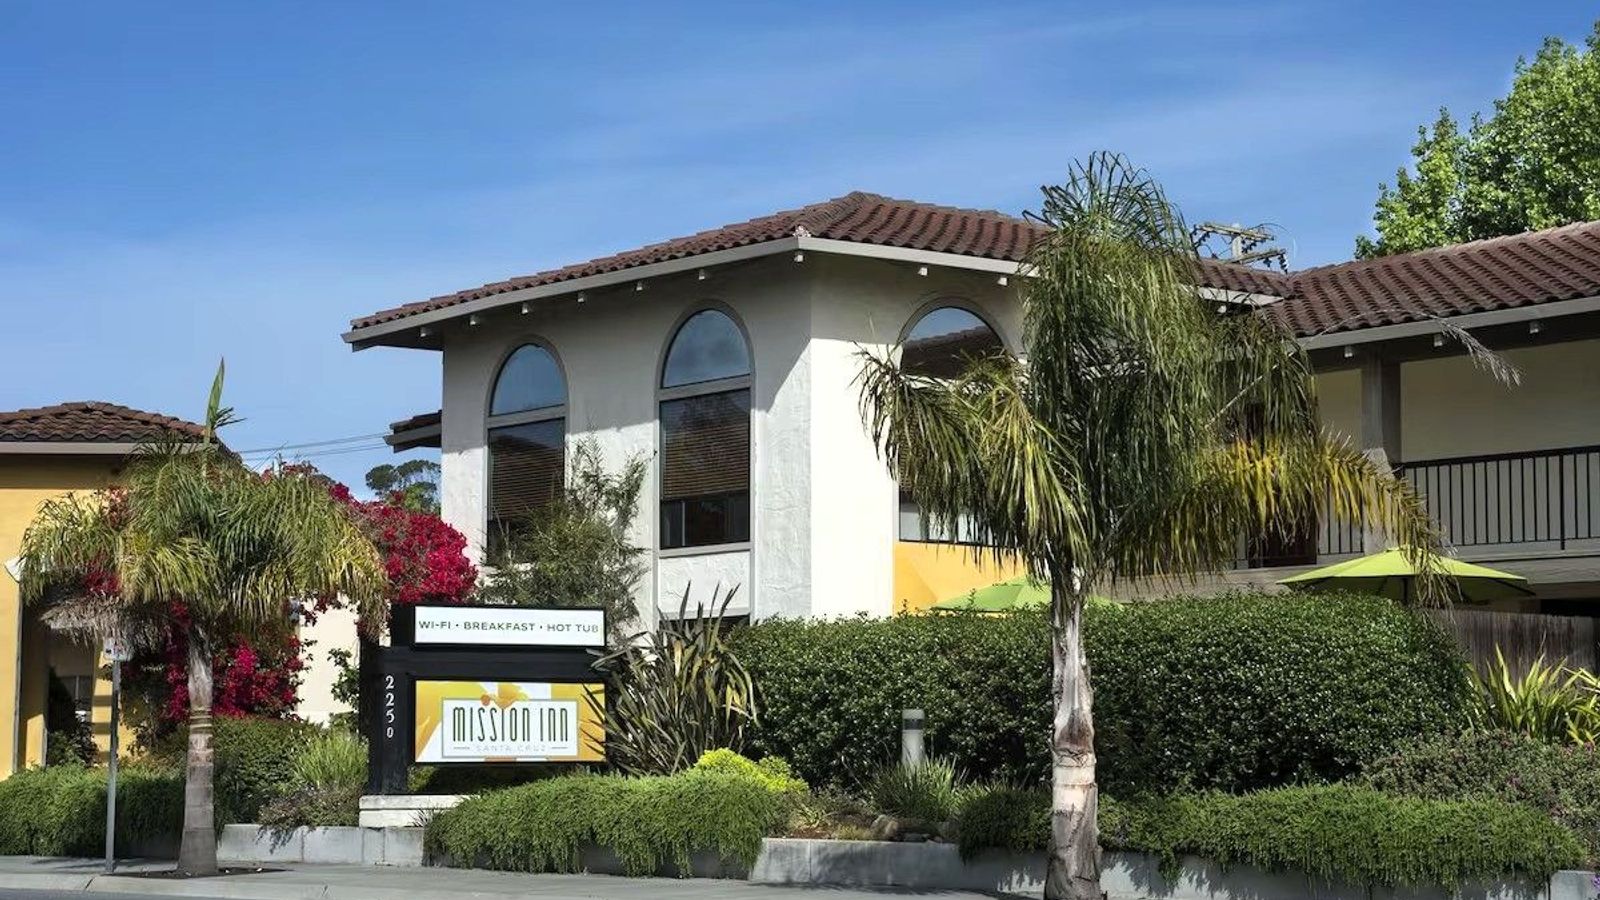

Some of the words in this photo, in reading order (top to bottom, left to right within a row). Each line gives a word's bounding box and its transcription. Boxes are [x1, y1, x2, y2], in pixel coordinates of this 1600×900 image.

[418, 621, 451, 630] WI-FI
[463, 621, 536, 632] BREAKFAST
[546, 623, 572, 632] HOT
[575, 623, 599, 633] TUB
[385, 674, 395, 739] 2250
[453, 706, 531, 742] MISSION
[540, 707, 568, 742] INN
[474, 744, 513, 752] SANTA
[517, 744, 546, 752] CRUZ
